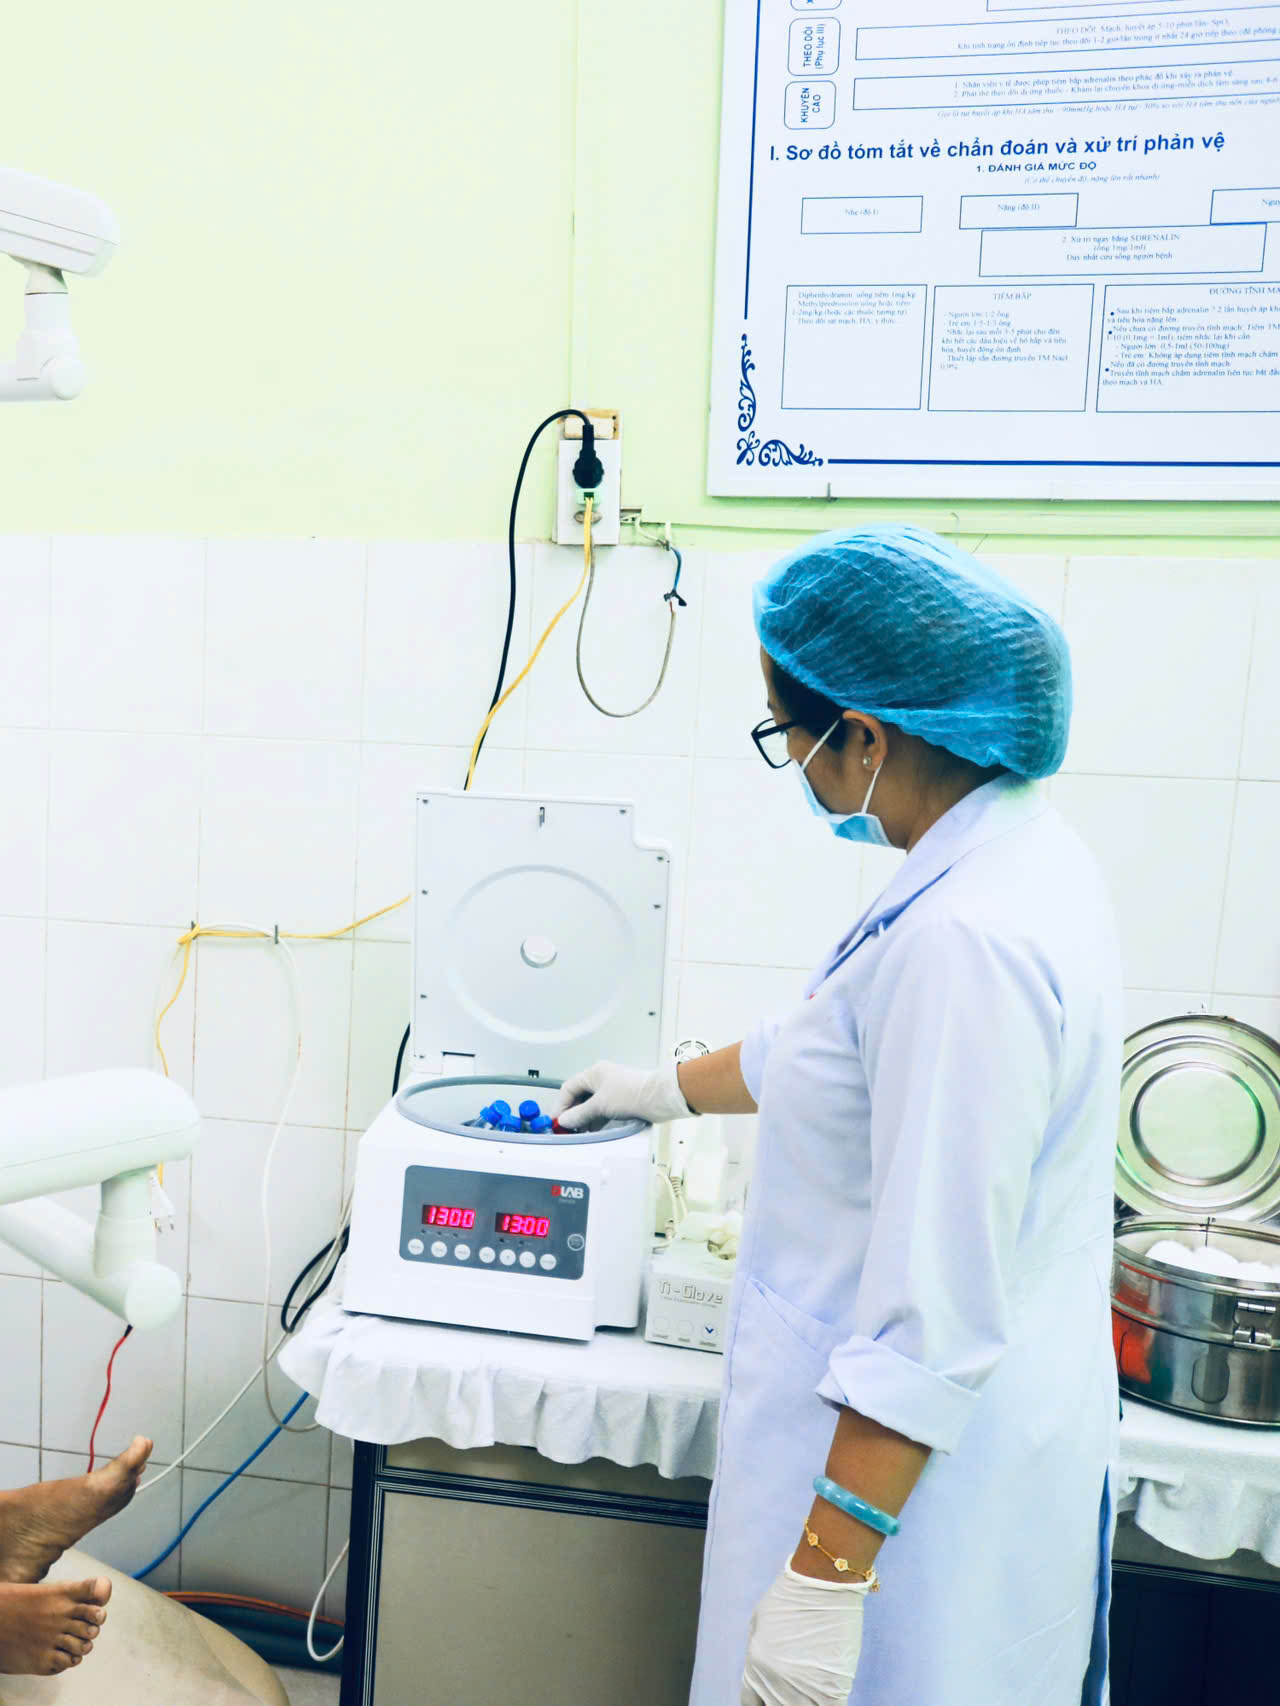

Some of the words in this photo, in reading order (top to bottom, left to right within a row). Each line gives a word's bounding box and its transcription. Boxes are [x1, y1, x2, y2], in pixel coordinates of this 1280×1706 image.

[770, 145, 780, 160] I.
[786, 145, 813, 161] Sơ
[818, 141, 841, 160] đồ
[847, 144, 883, 160] tóm
[889, 138, 914, 159] tắt
[920, 138, 941, 158] về
[947, 137, 993, 157] chẩn
[1000, 139, 1048, 156] đoán
[1055, 138, 1078, 154] và
[1084, 136, 1111, 153] xử
[1117, 136, 1137, 152] trí
[1144, 134, 1194, 155] phản
[1201, 131, 1225, 152] vệ
[988, 162, 1022, 173] ĐÁNH
[1024, 161, 1045, 172] GIÁ
[1048, 160, 1075, 172] MỨC
[1079, 160, 1097, 171] ĐỘ
[427, 1205, 476, 1229] 1300
